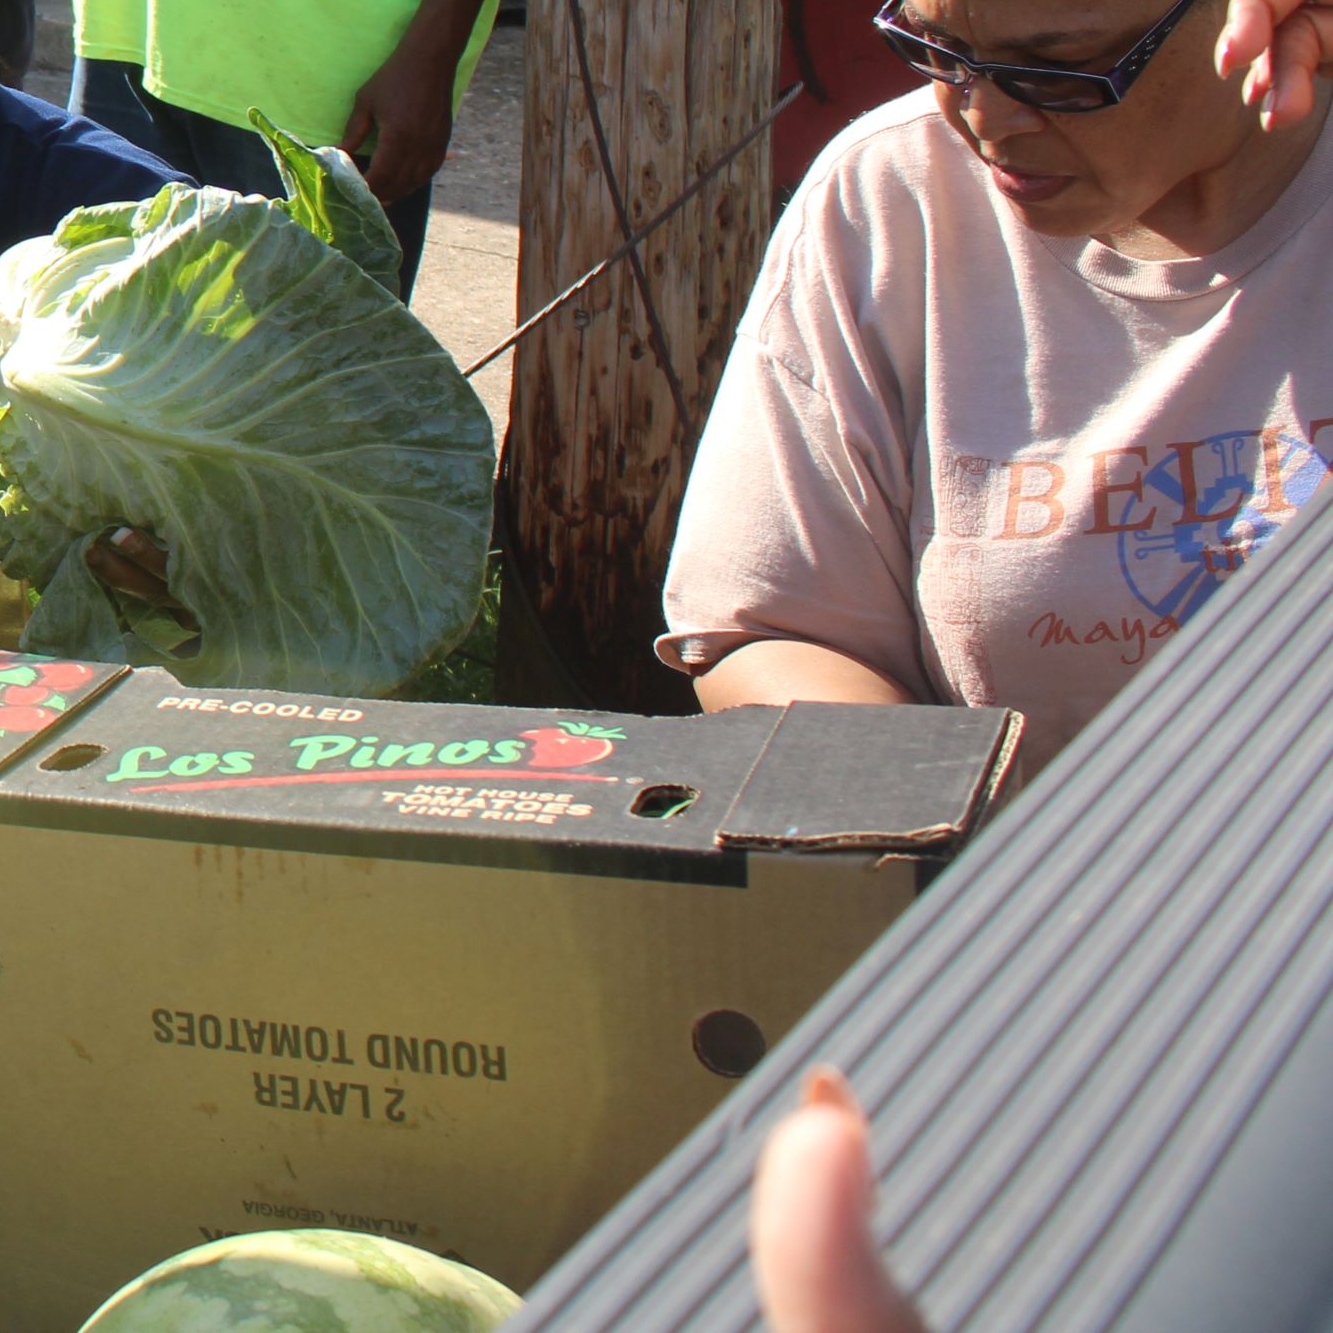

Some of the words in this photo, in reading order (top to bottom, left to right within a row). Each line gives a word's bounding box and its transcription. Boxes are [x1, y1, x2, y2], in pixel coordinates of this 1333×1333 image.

[992, 417, 1333, 543] BELI
[155, 695, 364, 723] PRE-COOLED
[106, 744, 256, 782] Los
[287, 733, 526, 771] Pinos
[382, 791, 595, 817] TOMATOES
[397, 804, 473, 818] VINE
[479, 810, 559, 825] RIPE
[412, 784, 473, 796] HOT
[476, 787, 575, 803] HOUSE
[151, 1007, 355, 1066] TOMATOES
[366, 1032, 508, 1082] ROUND
[252, 1071, 371, 1119] LAYER
[384, 1086, 407, 1123] 2
